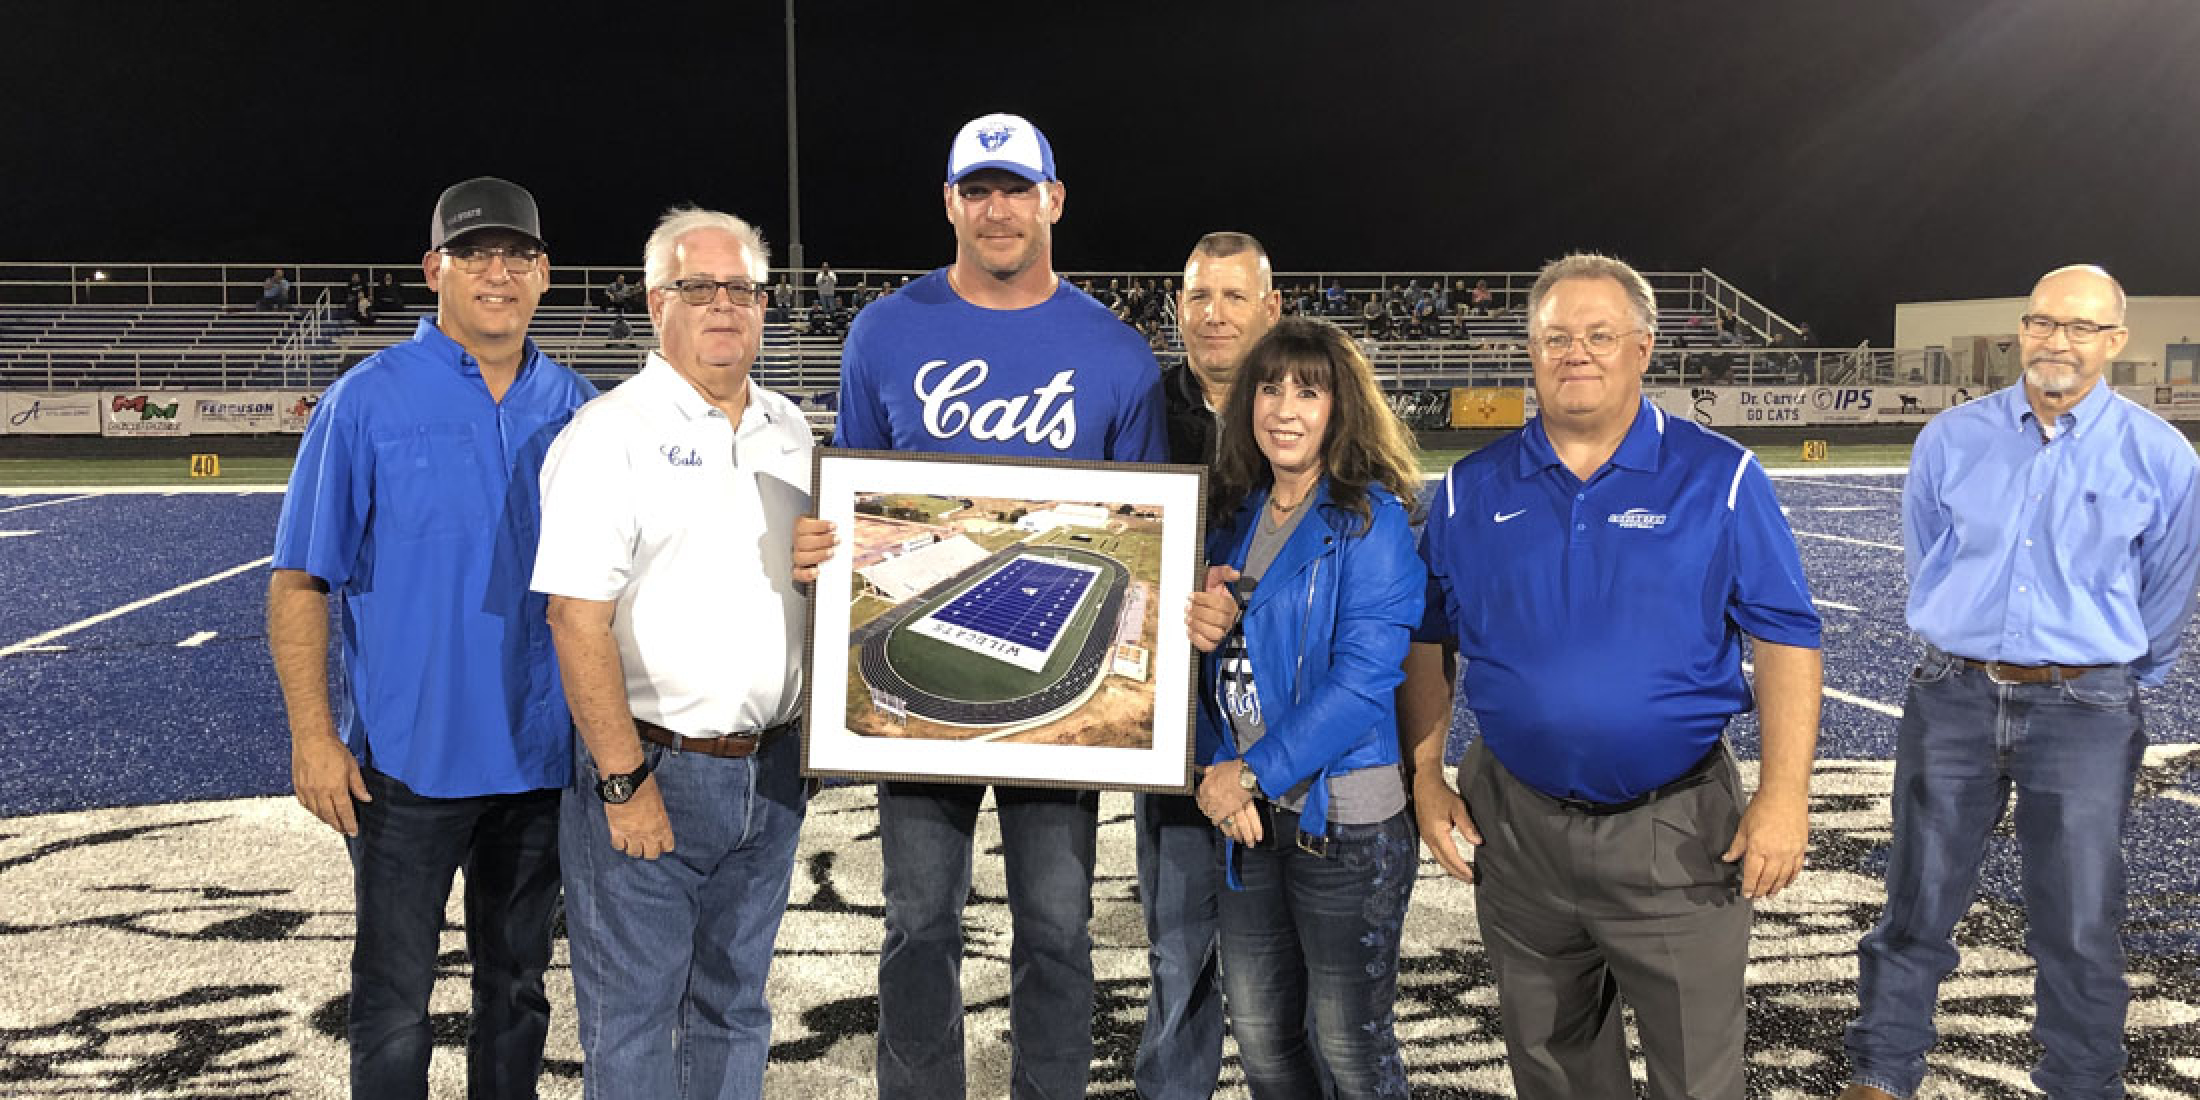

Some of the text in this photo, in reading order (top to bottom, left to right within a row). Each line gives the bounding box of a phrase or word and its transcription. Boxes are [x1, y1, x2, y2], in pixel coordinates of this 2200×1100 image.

[913, 359, 1077, 451] Cats
[1741, 391, 1759, 404] Dr.
[1747, 409, 1799, 421] GO CATS
[659, 444, 703, 467] Cats
[1807, 441, 1825, 459] 30
[193, 456, 215, 475] 40
